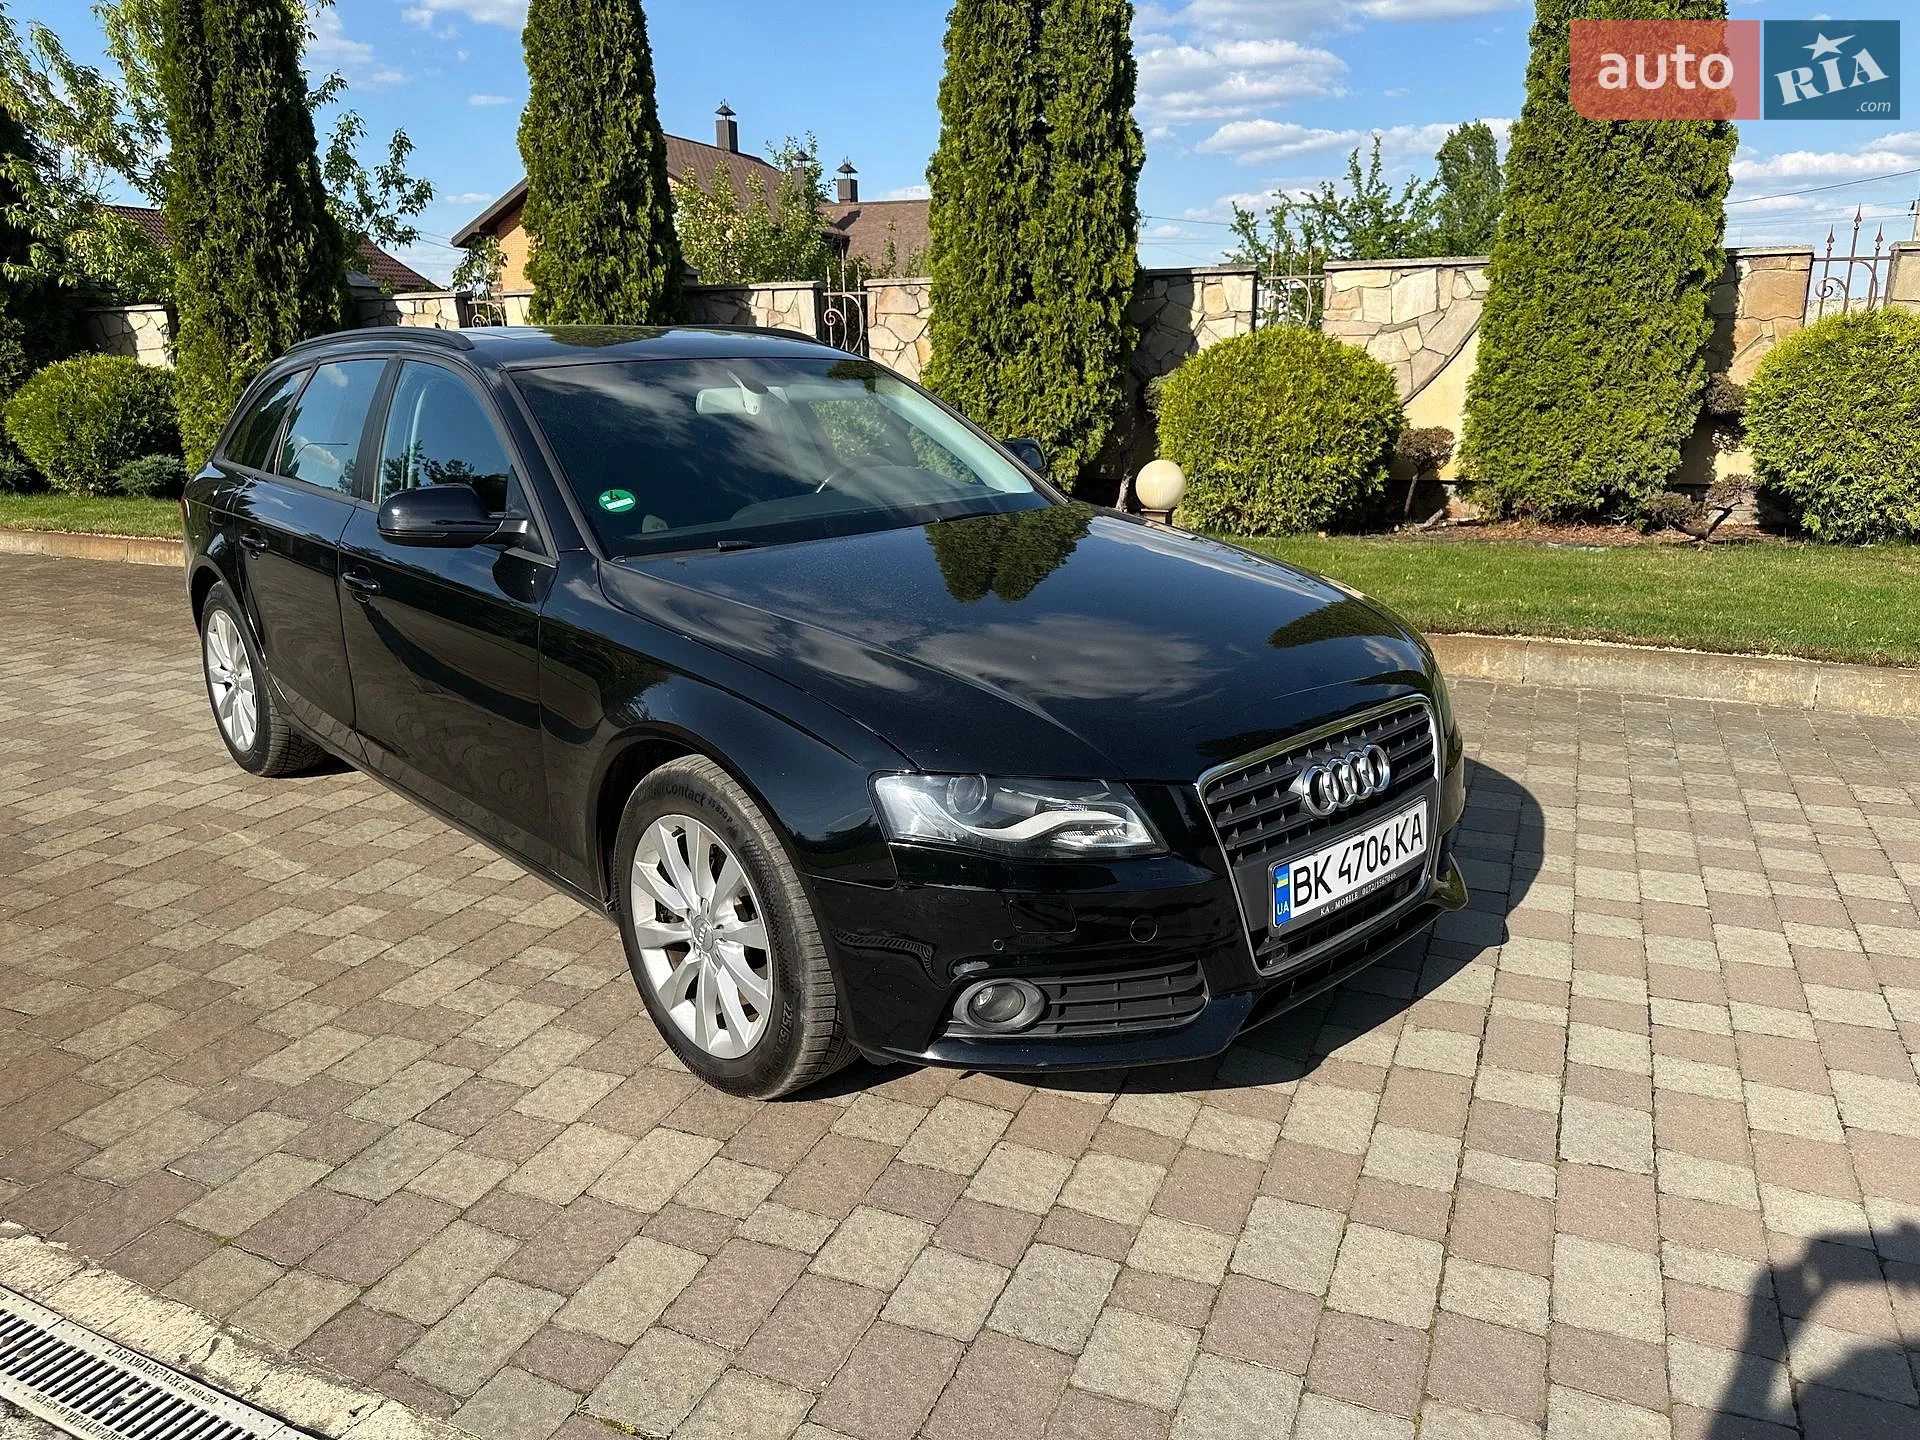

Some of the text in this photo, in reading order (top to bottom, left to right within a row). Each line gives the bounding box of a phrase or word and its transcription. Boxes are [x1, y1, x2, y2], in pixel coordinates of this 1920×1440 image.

[1293, 812, 1423, 908] BK 4706 KA
[1276, 901, 1290, 916] UA
[1320, 906, 1330, 917] KA
[1334, 891, 1359, 910] MOBILE
